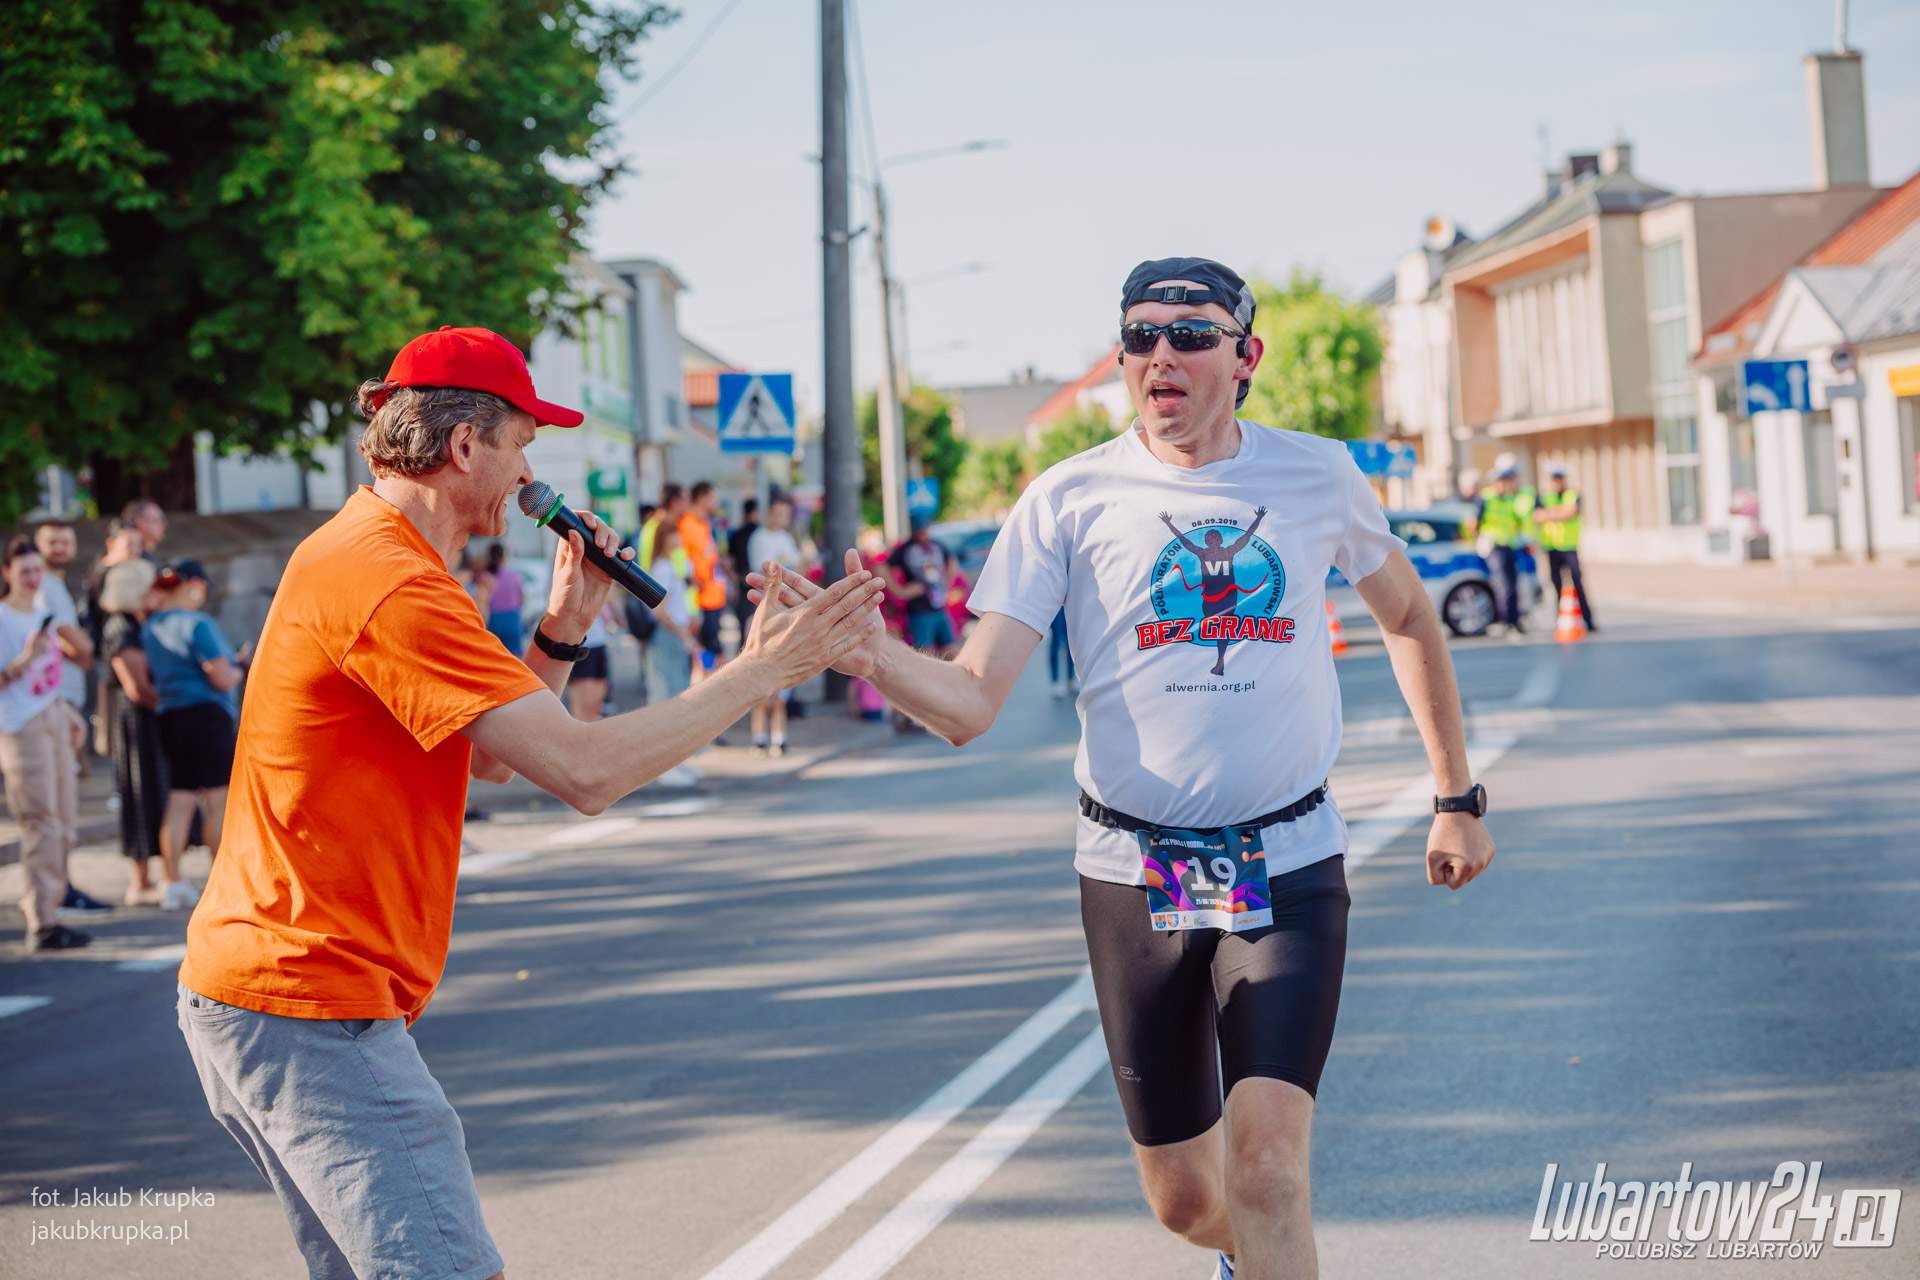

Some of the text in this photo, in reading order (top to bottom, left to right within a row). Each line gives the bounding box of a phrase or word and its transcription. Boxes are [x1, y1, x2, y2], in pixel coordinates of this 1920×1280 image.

[1205, 560, 1230, 576] VI
[1251, 540, 1282, 615] LUBARTOWSKI
[1136, 619, 1194, 650] BEZ
[1165, 680, 1255, 693] alwernia.org.pl
[1187, 856, 1237, 892] 19
